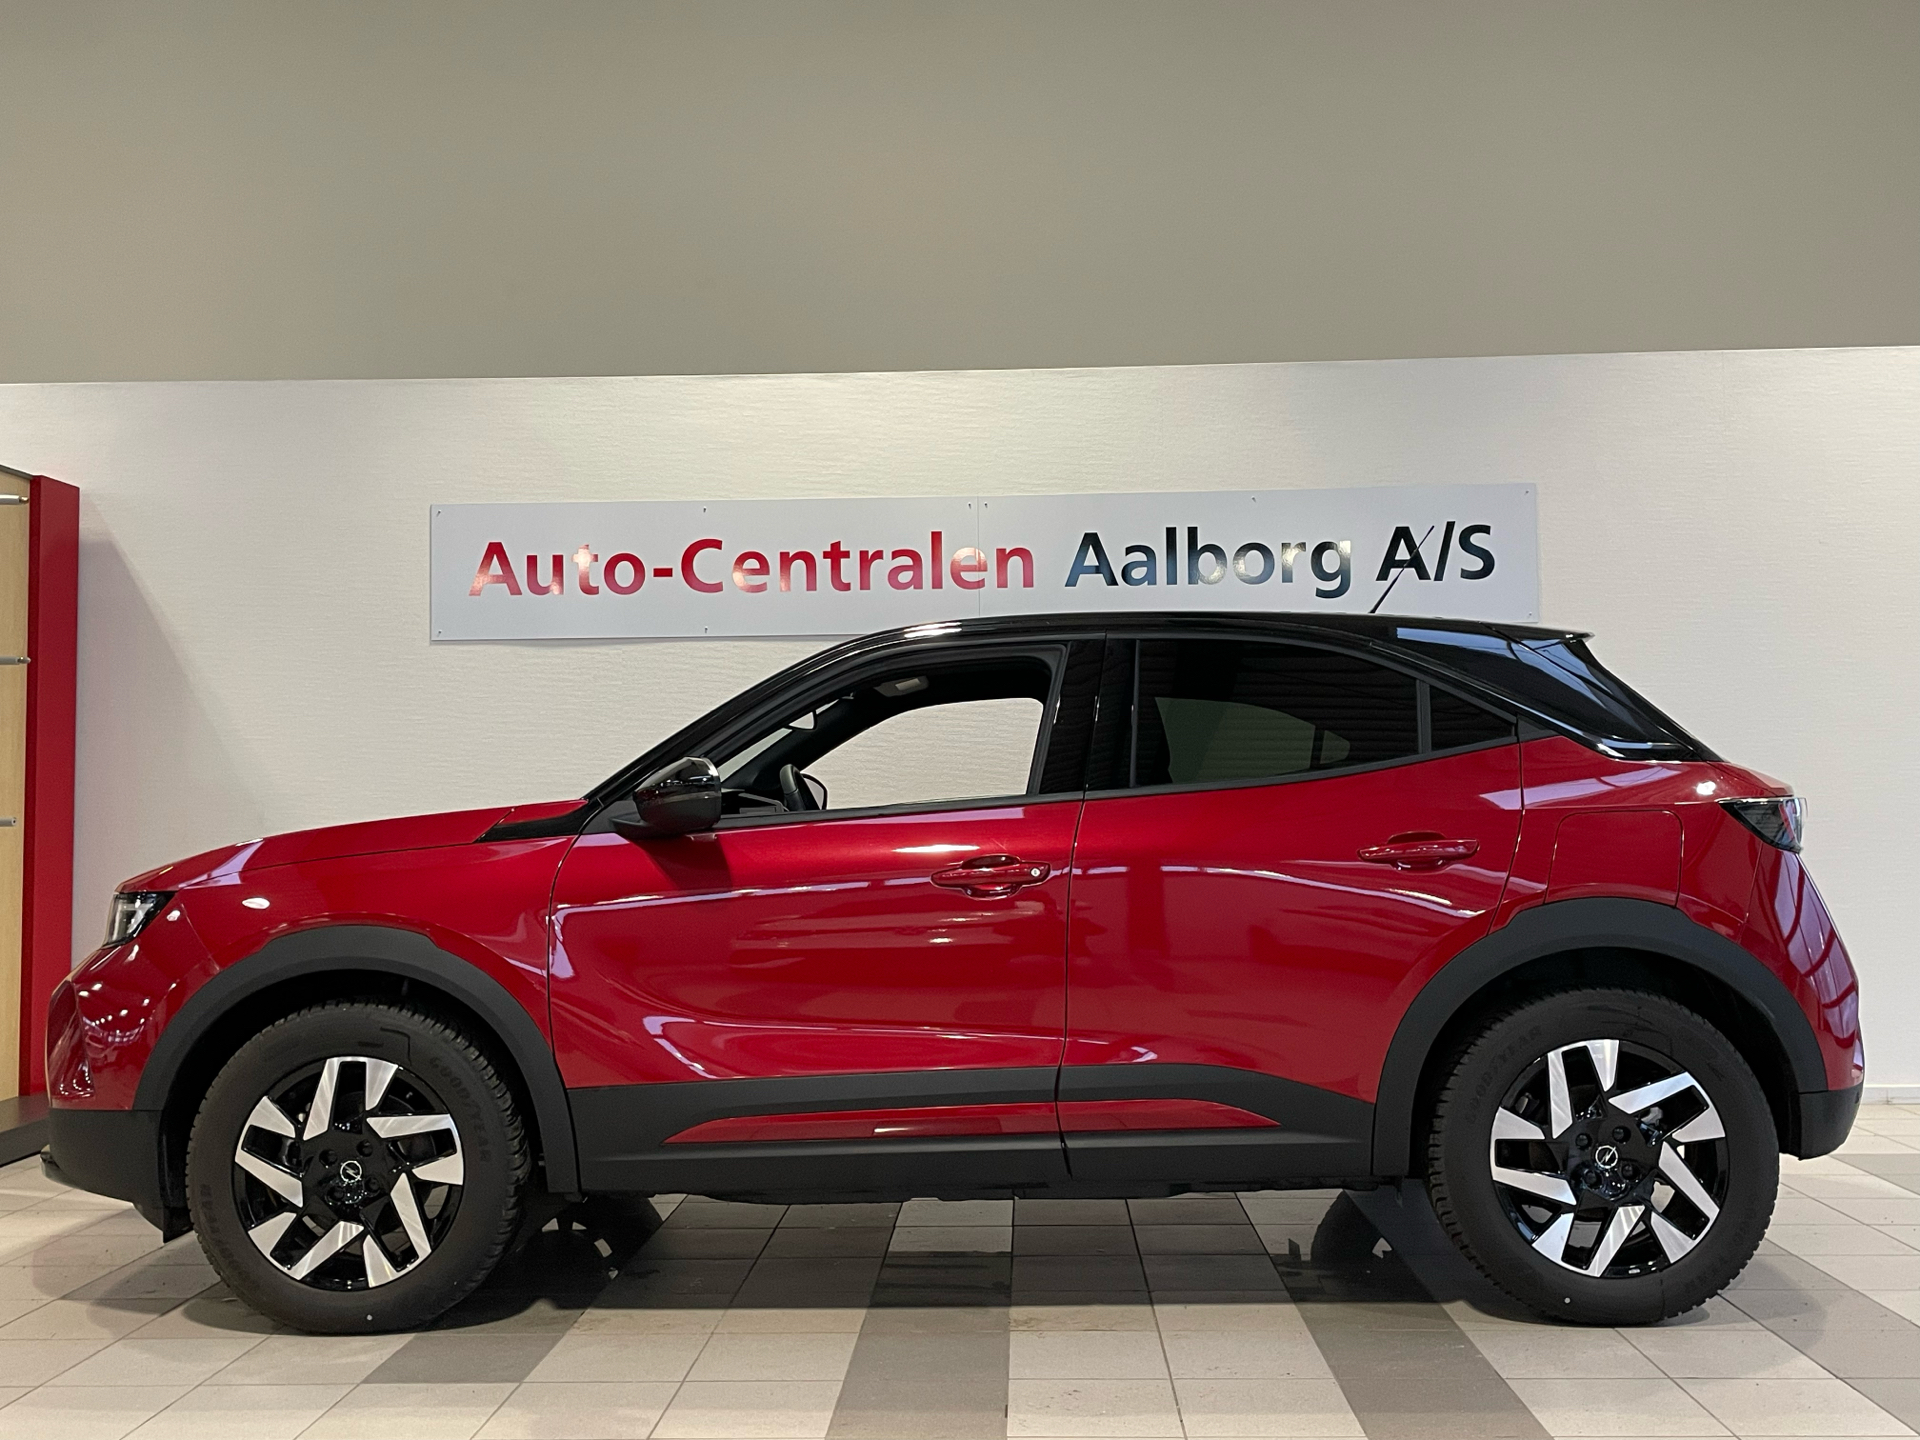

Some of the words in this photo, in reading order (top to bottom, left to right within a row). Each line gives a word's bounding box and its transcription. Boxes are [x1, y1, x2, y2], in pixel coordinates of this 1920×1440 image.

[468, 530, 1035, 597] Auto-Centralen
[1065, 526, 1351, 598] Aalborg
[1376, 521, 1495, 581] A/S
